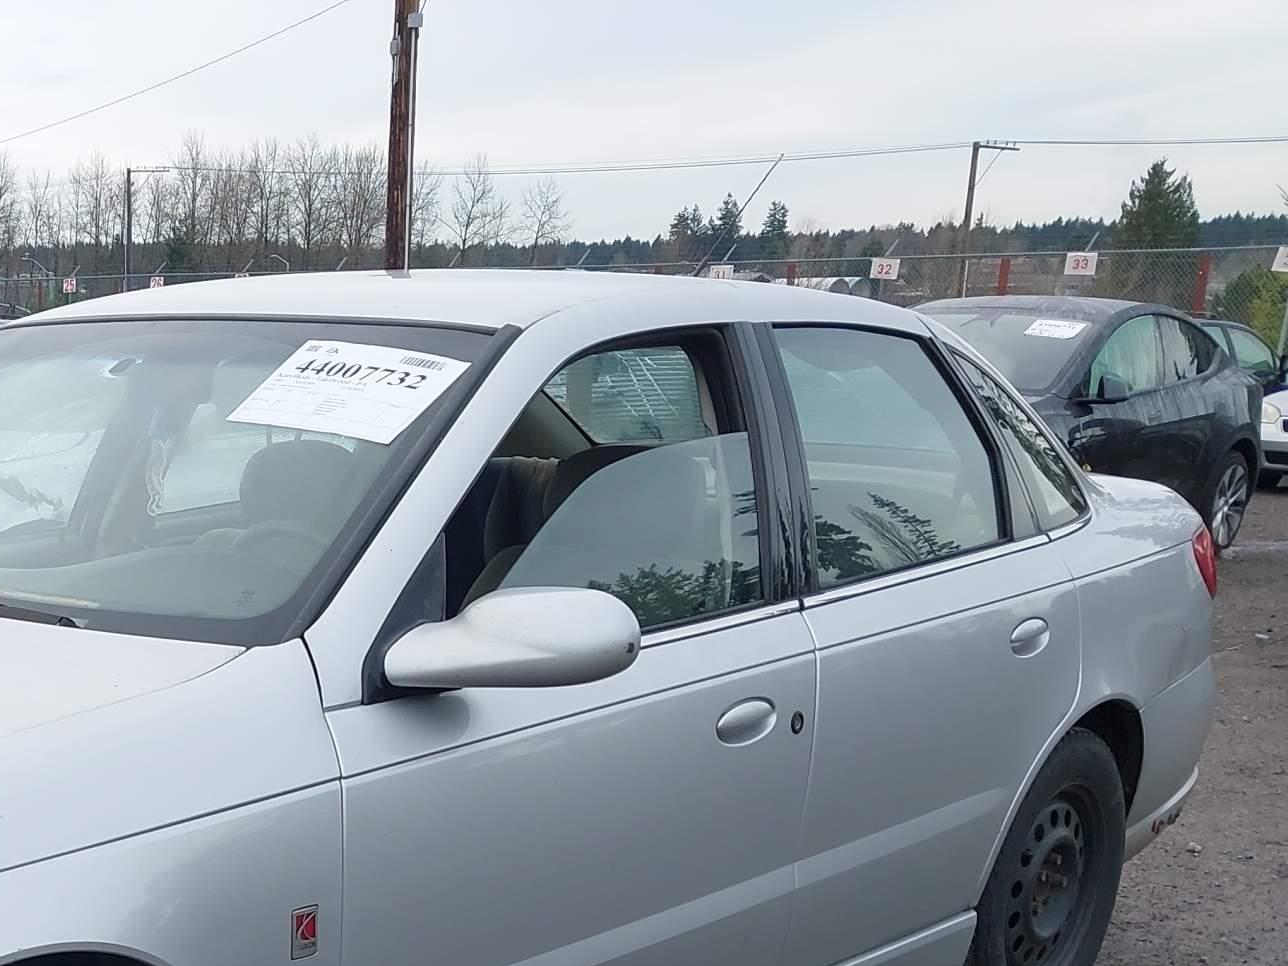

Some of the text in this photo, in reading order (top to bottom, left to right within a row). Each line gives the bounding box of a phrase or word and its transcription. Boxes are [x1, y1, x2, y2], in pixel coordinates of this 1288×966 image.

[877, 263, 892, 275] 32
[1072, 258, 1089, 270] 33
[64, 278, 75, 292] 25
[295, 358, 428, 390] 44007732
